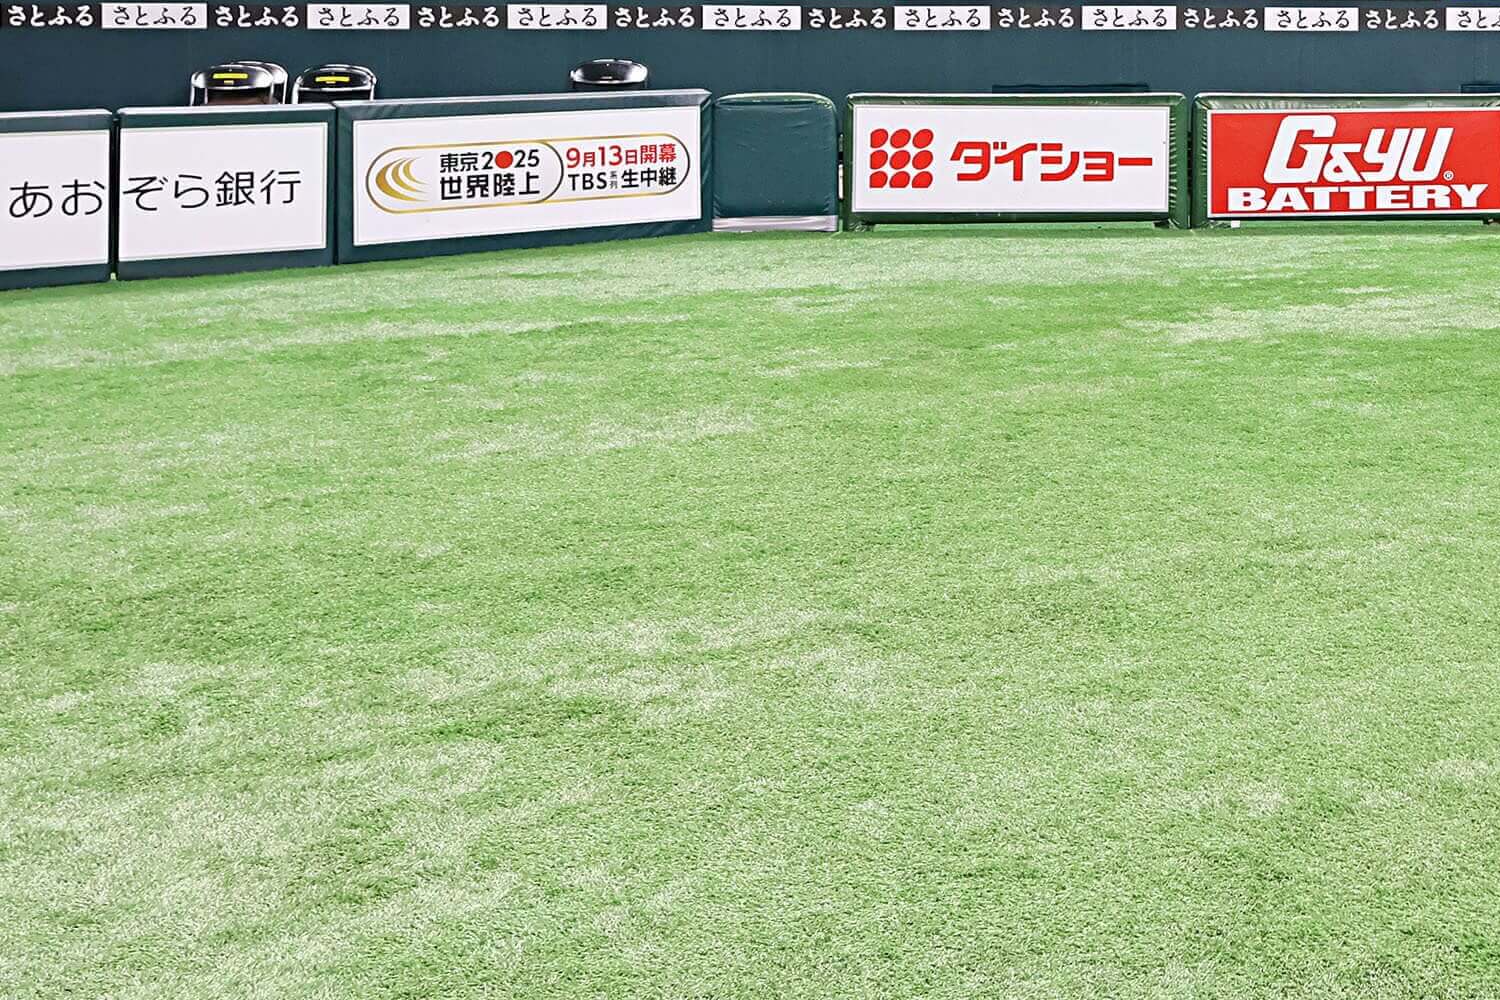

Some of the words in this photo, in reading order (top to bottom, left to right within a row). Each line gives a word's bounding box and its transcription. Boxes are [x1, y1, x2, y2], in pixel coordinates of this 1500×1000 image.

[7, 3, 95, 27] さとふる
[112, 5, 198, 26] さとふる
[214, 4, 299, 27] さとふる
[317, 6, 401, 27] さとふる
[416, 6, 500, 29] さとふる
[518, 7, 598, 27] さとふる
[613, 6, 695, 29] さとふる
[713, 7, 793, 27] さとふる
[808, 8, 888, 29] さとふる
[904, 8, 982, 28] さとふる
[996, 8, 1075, 29] さとふる
[1092, 8, 1169, 28] さとふる
[1183, 8, 1259, 29] さとふる
[1276, 9, 1351, 28] さとふる
[1365, 8, 1440, 29] さとふる
[565, 142, 677, 169] 9月13日開幕
[950, 140, 1153, 183] ダイショー
[439, 171, 541, 200] 世界陸上
[1226, 183, 1489, 212] BATTERY
